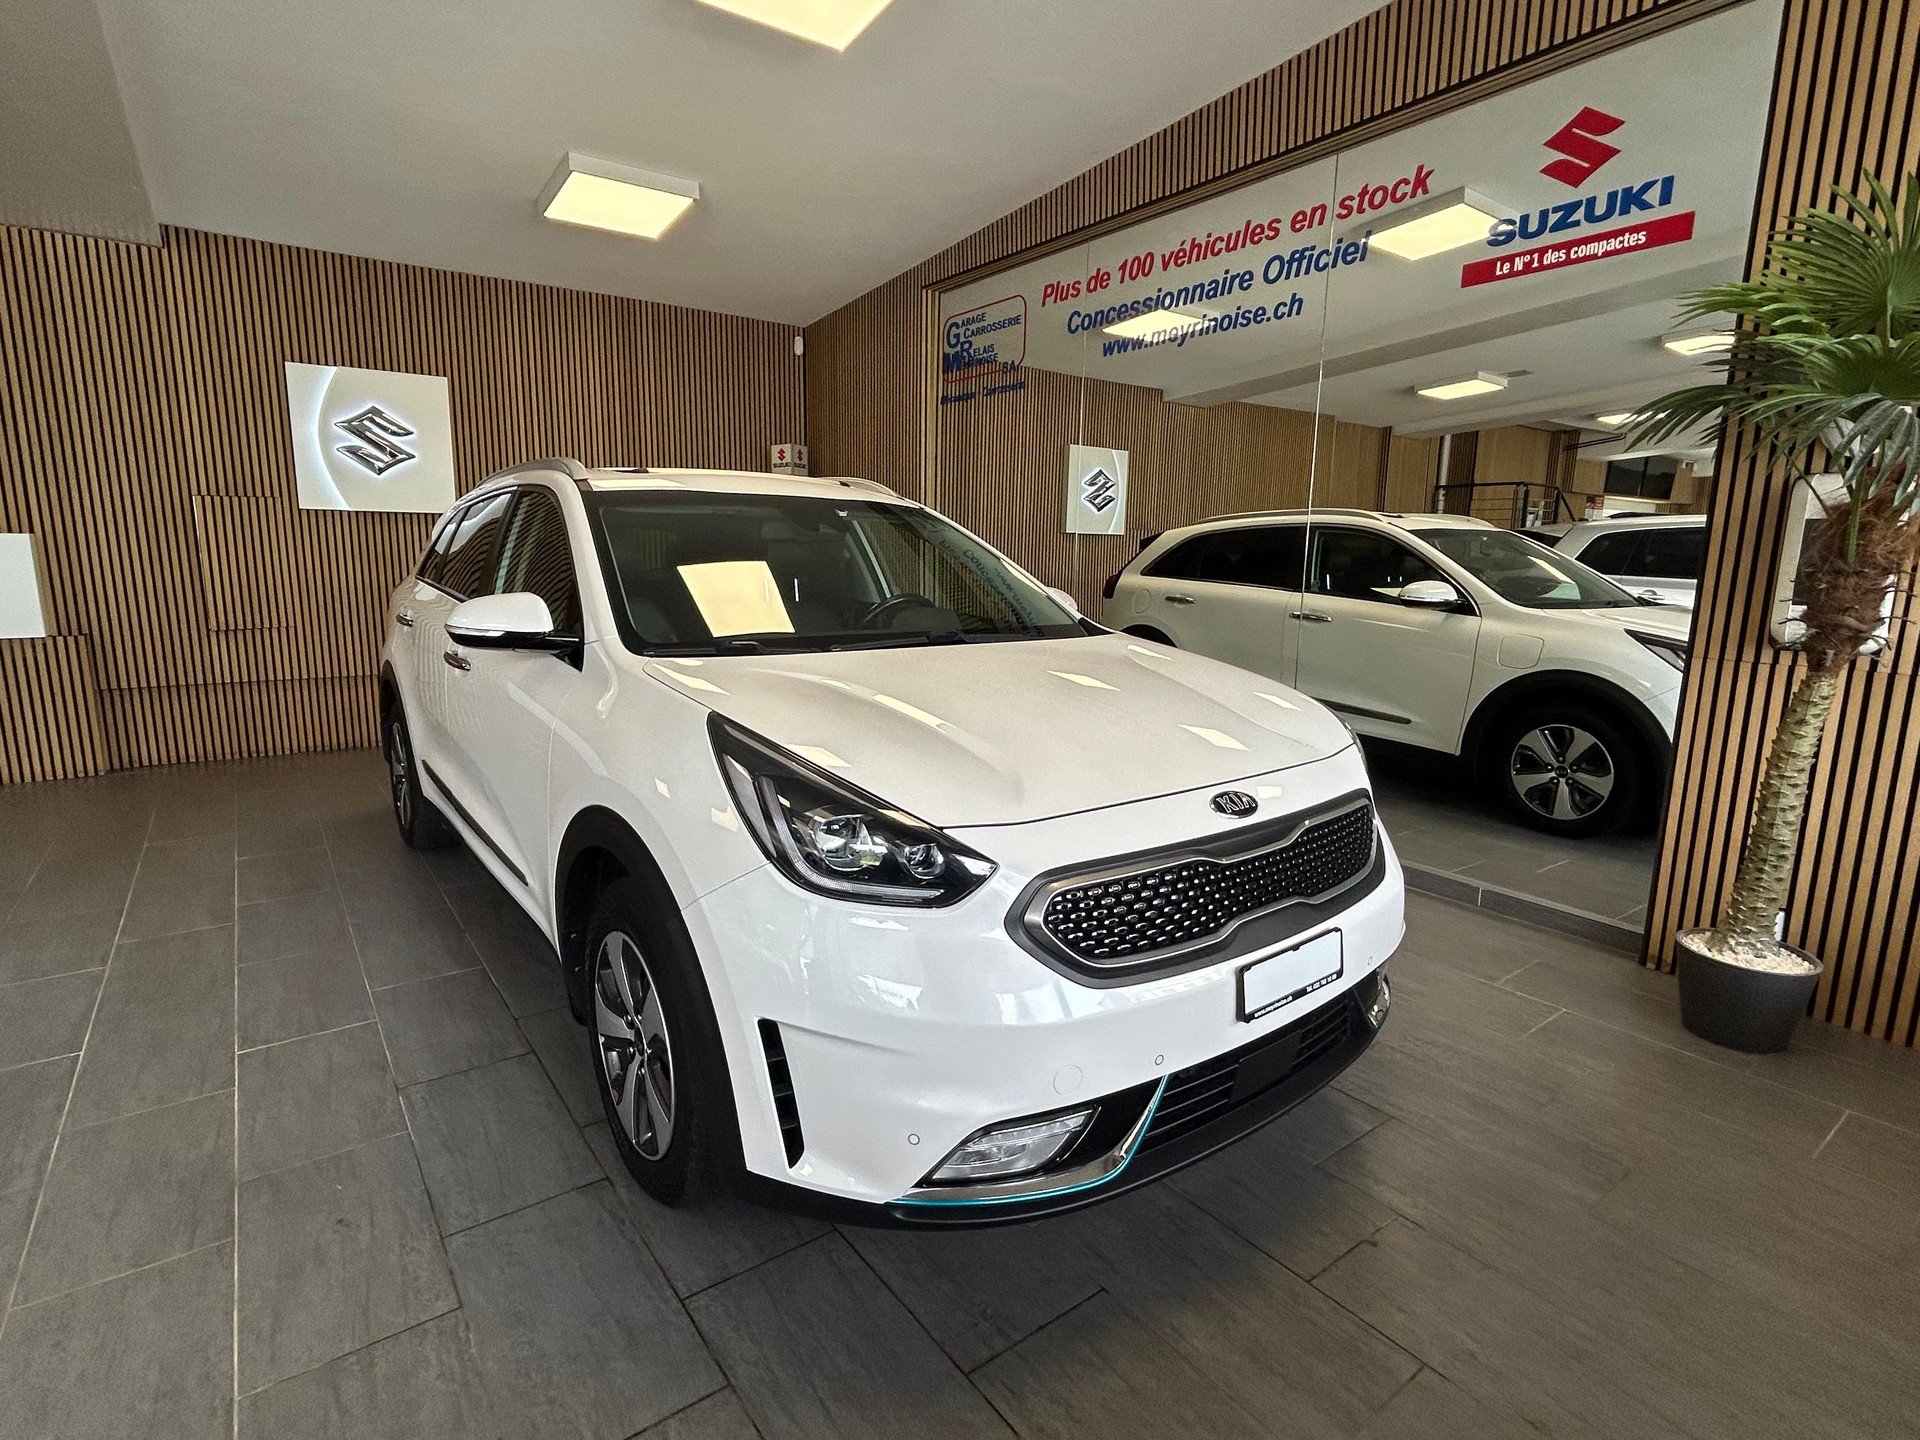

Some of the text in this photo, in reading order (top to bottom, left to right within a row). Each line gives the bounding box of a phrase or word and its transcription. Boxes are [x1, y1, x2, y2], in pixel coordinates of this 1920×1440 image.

[1041, 163, 1435, 307] Plus de 100 véhicules en stock
[1486, 175, 1675, 247] SUZUKI
[1067, 229, 1373, 335] Concessionnaire Officiel
[1495, 261, 1511, 276] Le
[1543, 249, 1567, 265] des
[1570, 230, 1647, 259] compactes
[964, 315, 1022, 340] CARROSSERIE
[1102, 292, 1304, 357] www.meyrinoise.ch
[1215, 792, 1256, 813] KIA
